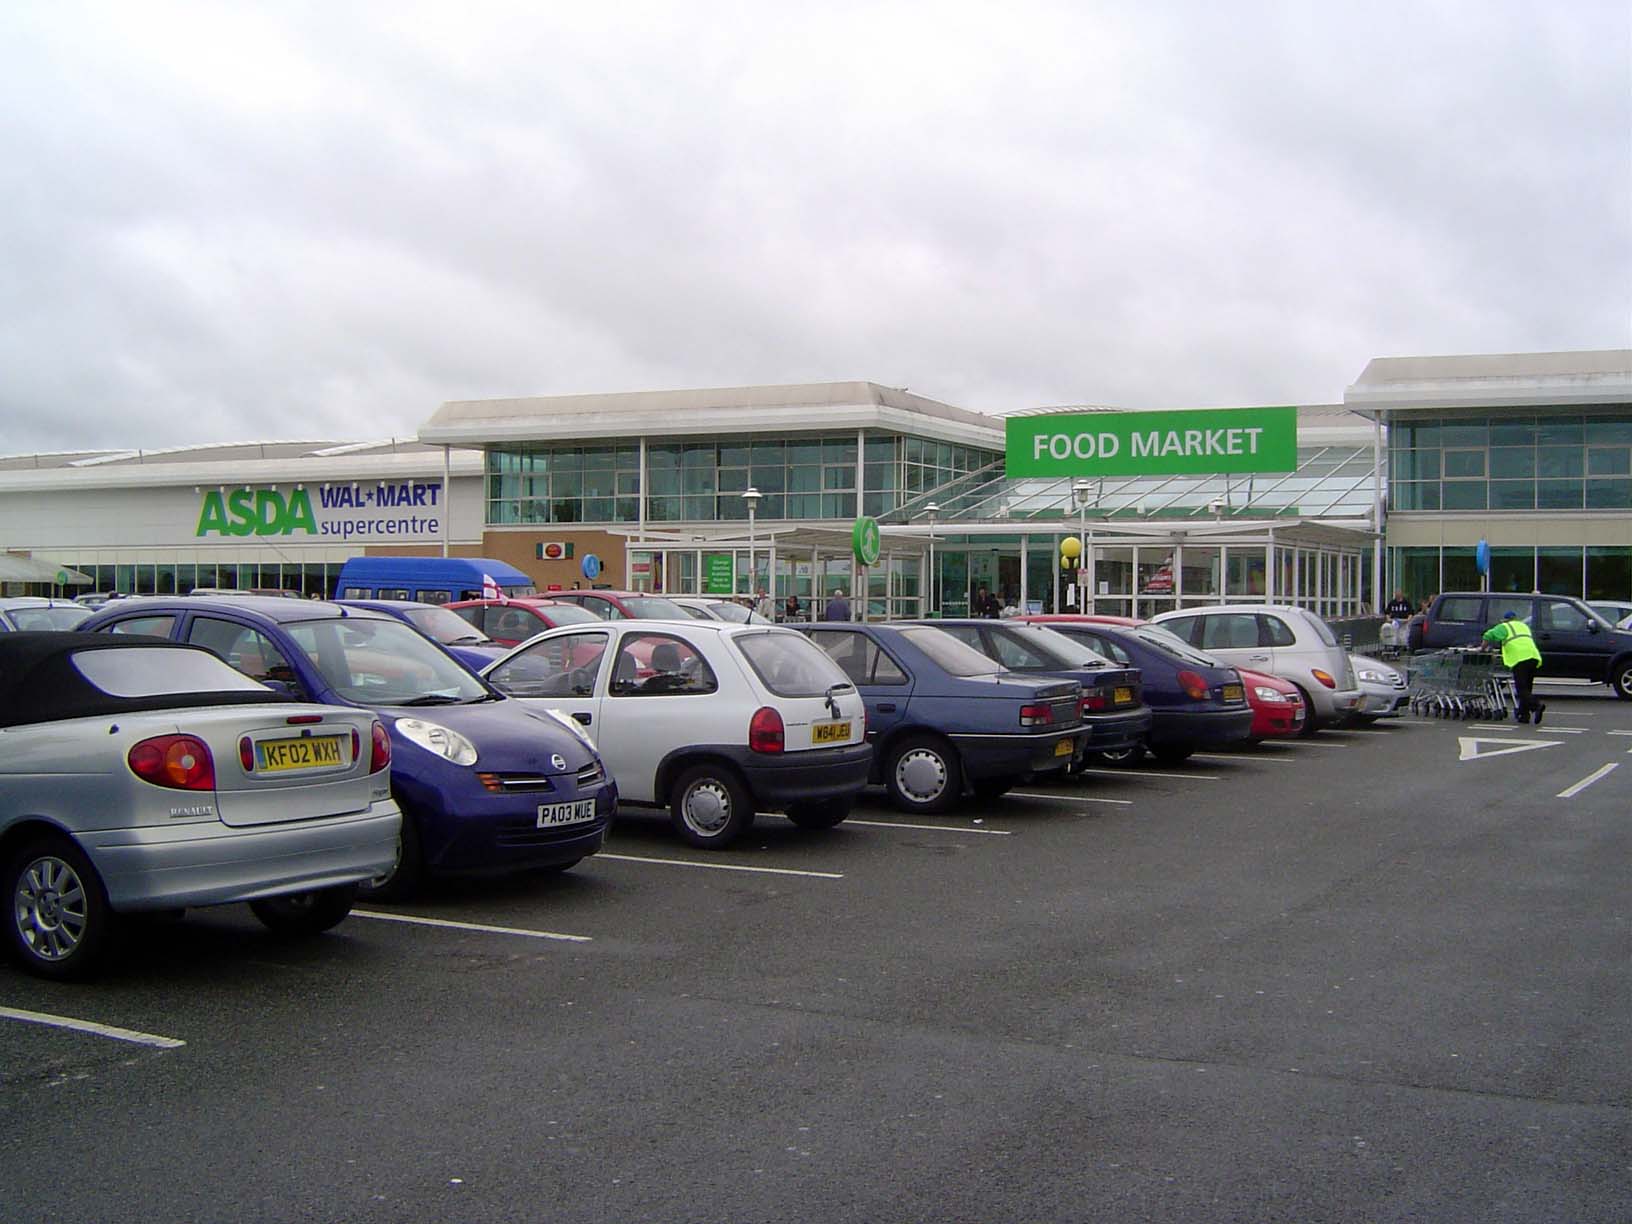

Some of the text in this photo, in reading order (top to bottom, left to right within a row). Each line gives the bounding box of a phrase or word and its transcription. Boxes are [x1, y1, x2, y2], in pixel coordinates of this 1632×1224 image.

[1033, 427, 1264, 461] FOOD MARKET
[196, 488, 318, 537] ASDA
[321, 515, 440, 540] supercentre
[266, 741, 341, 767] KF02 WXH
[541, 804, 572, 825] PA03
